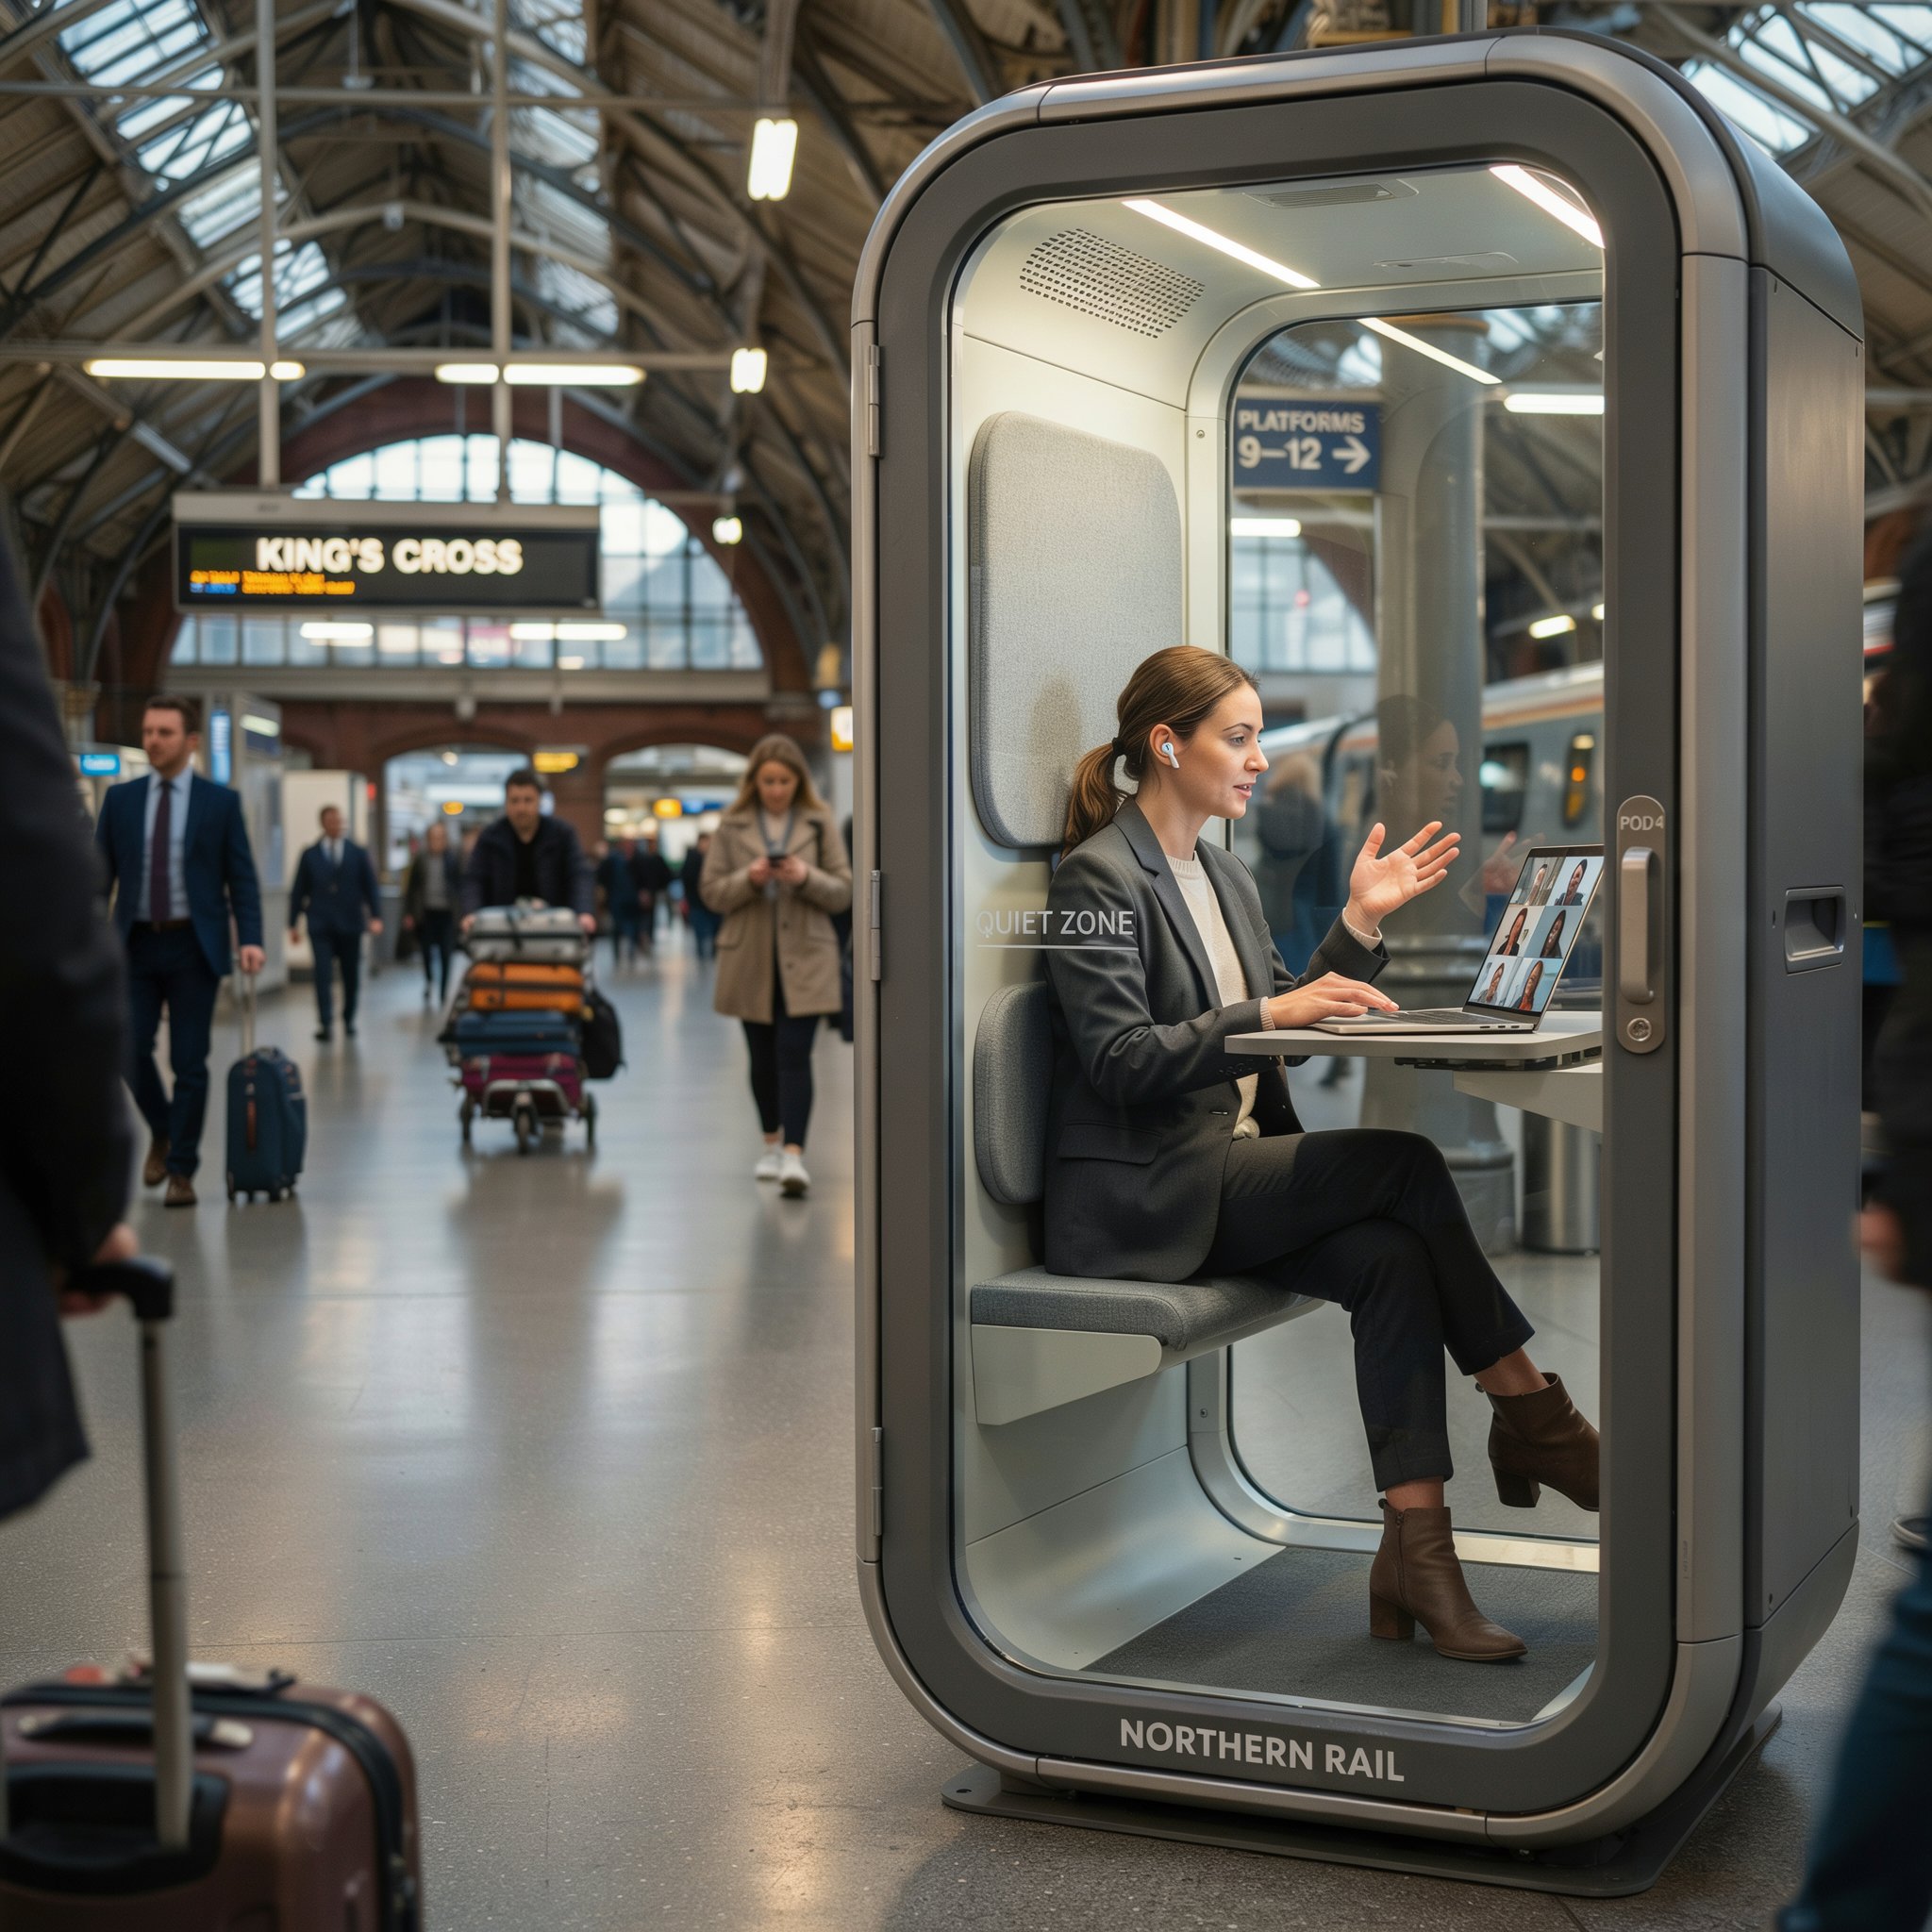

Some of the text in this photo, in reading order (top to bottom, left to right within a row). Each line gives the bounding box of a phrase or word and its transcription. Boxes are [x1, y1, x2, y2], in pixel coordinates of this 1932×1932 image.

[1238, 409, 1365, 434] PLATFORMS
[256, 536, 524, 575] KING'S CROSS
[975, 910, 1134, 939] QUIET ZONE
[1121, 1718, 1405, 1782] NORTHERN RAIL
